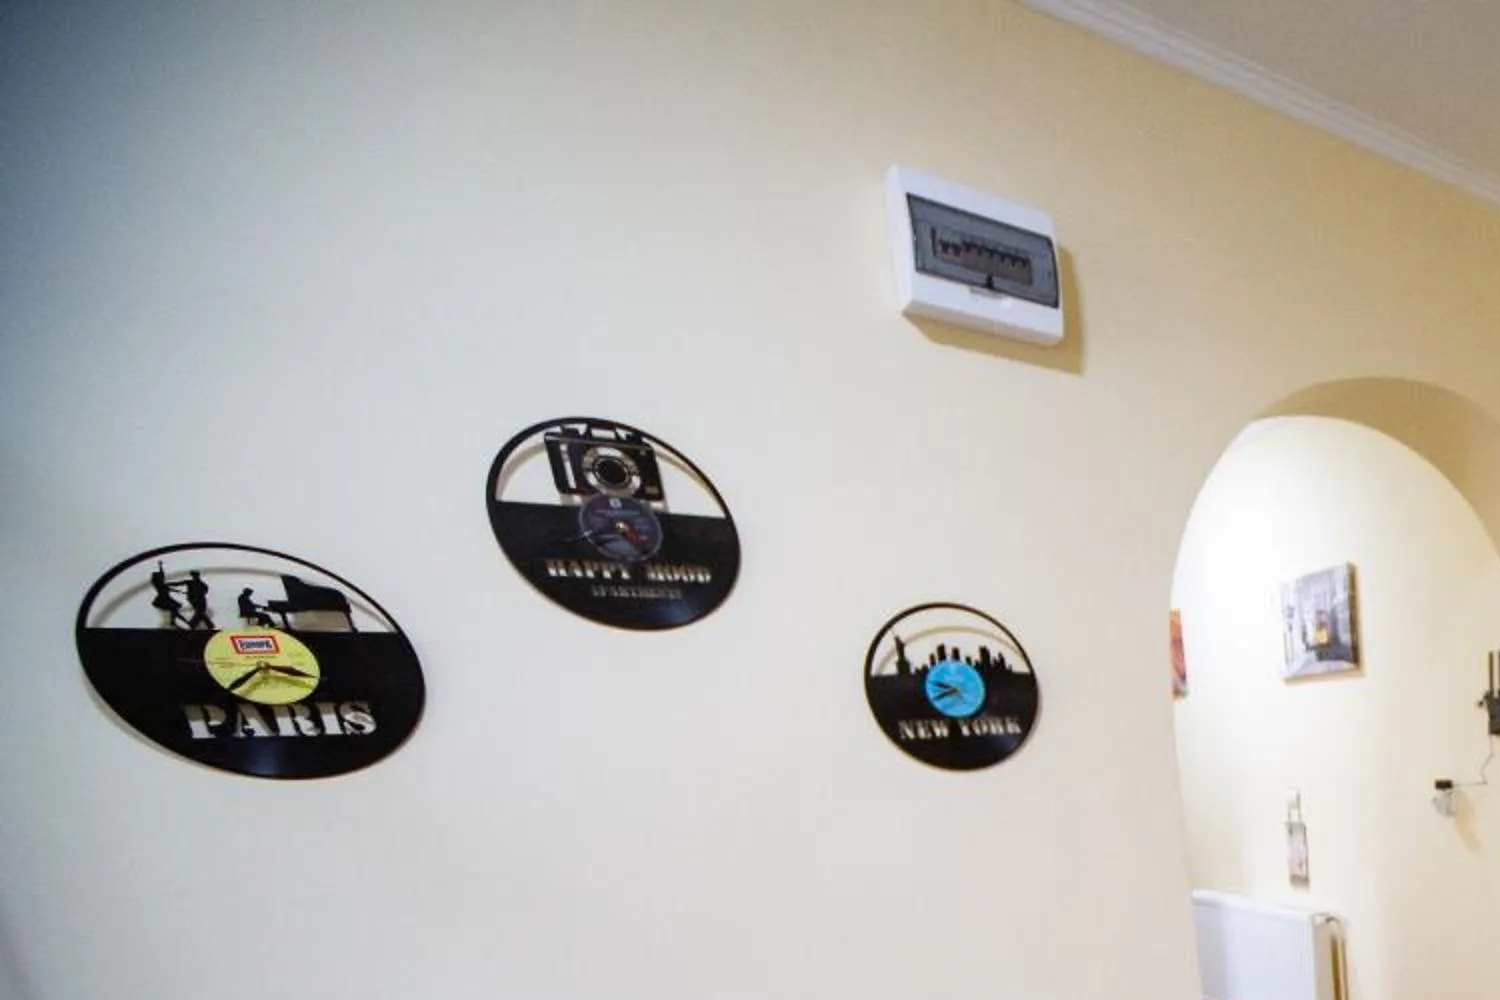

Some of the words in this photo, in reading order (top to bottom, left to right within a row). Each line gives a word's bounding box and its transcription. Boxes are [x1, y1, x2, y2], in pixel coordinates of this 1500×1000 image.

[183, 702, 377, 740] PARIS
[898, 718, 950, 741] NEW
[957, 714, 1022, 738] YORK
